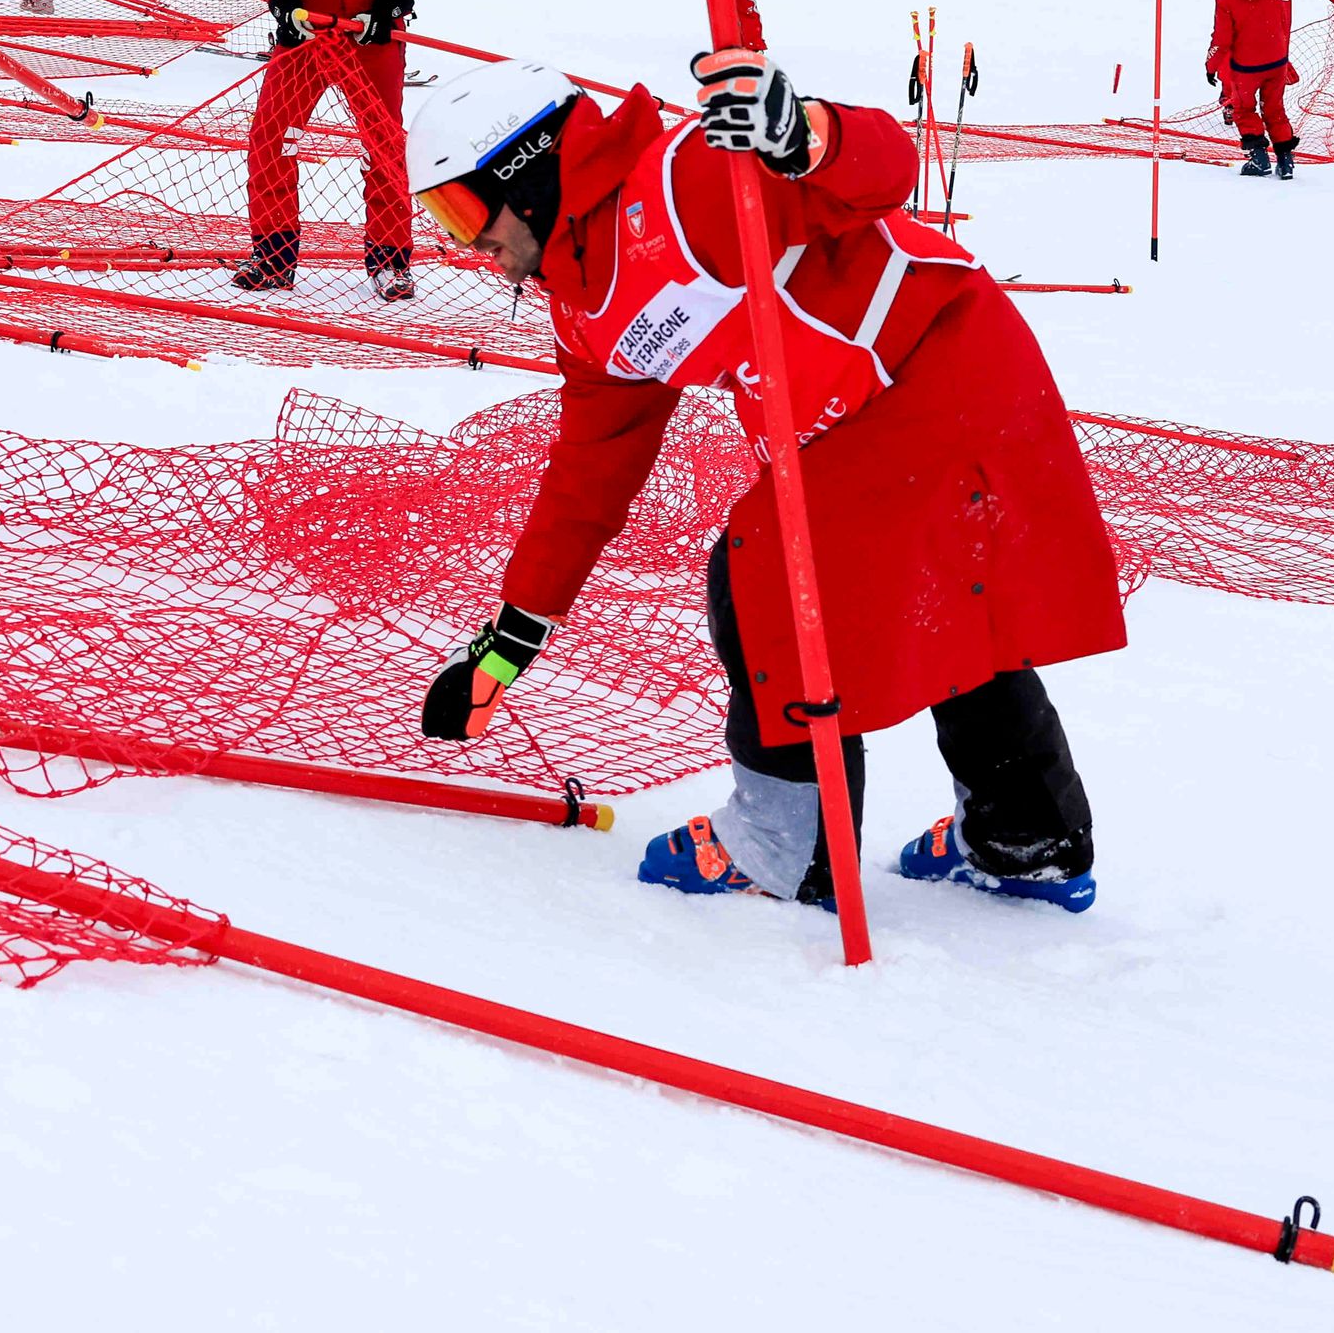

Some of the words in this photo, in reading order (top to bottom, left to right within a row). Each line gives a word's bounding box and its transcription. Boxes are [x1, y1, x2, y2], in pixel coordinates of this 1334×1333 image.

[470, 113, 520, 153] bollé
[493, 131, 552, 180] bollé
[620, 312, 654, 356] CAISSE
[632, 306, 690, 371] D'EPARGNE
[667, 337, 691, 362] Alpes
